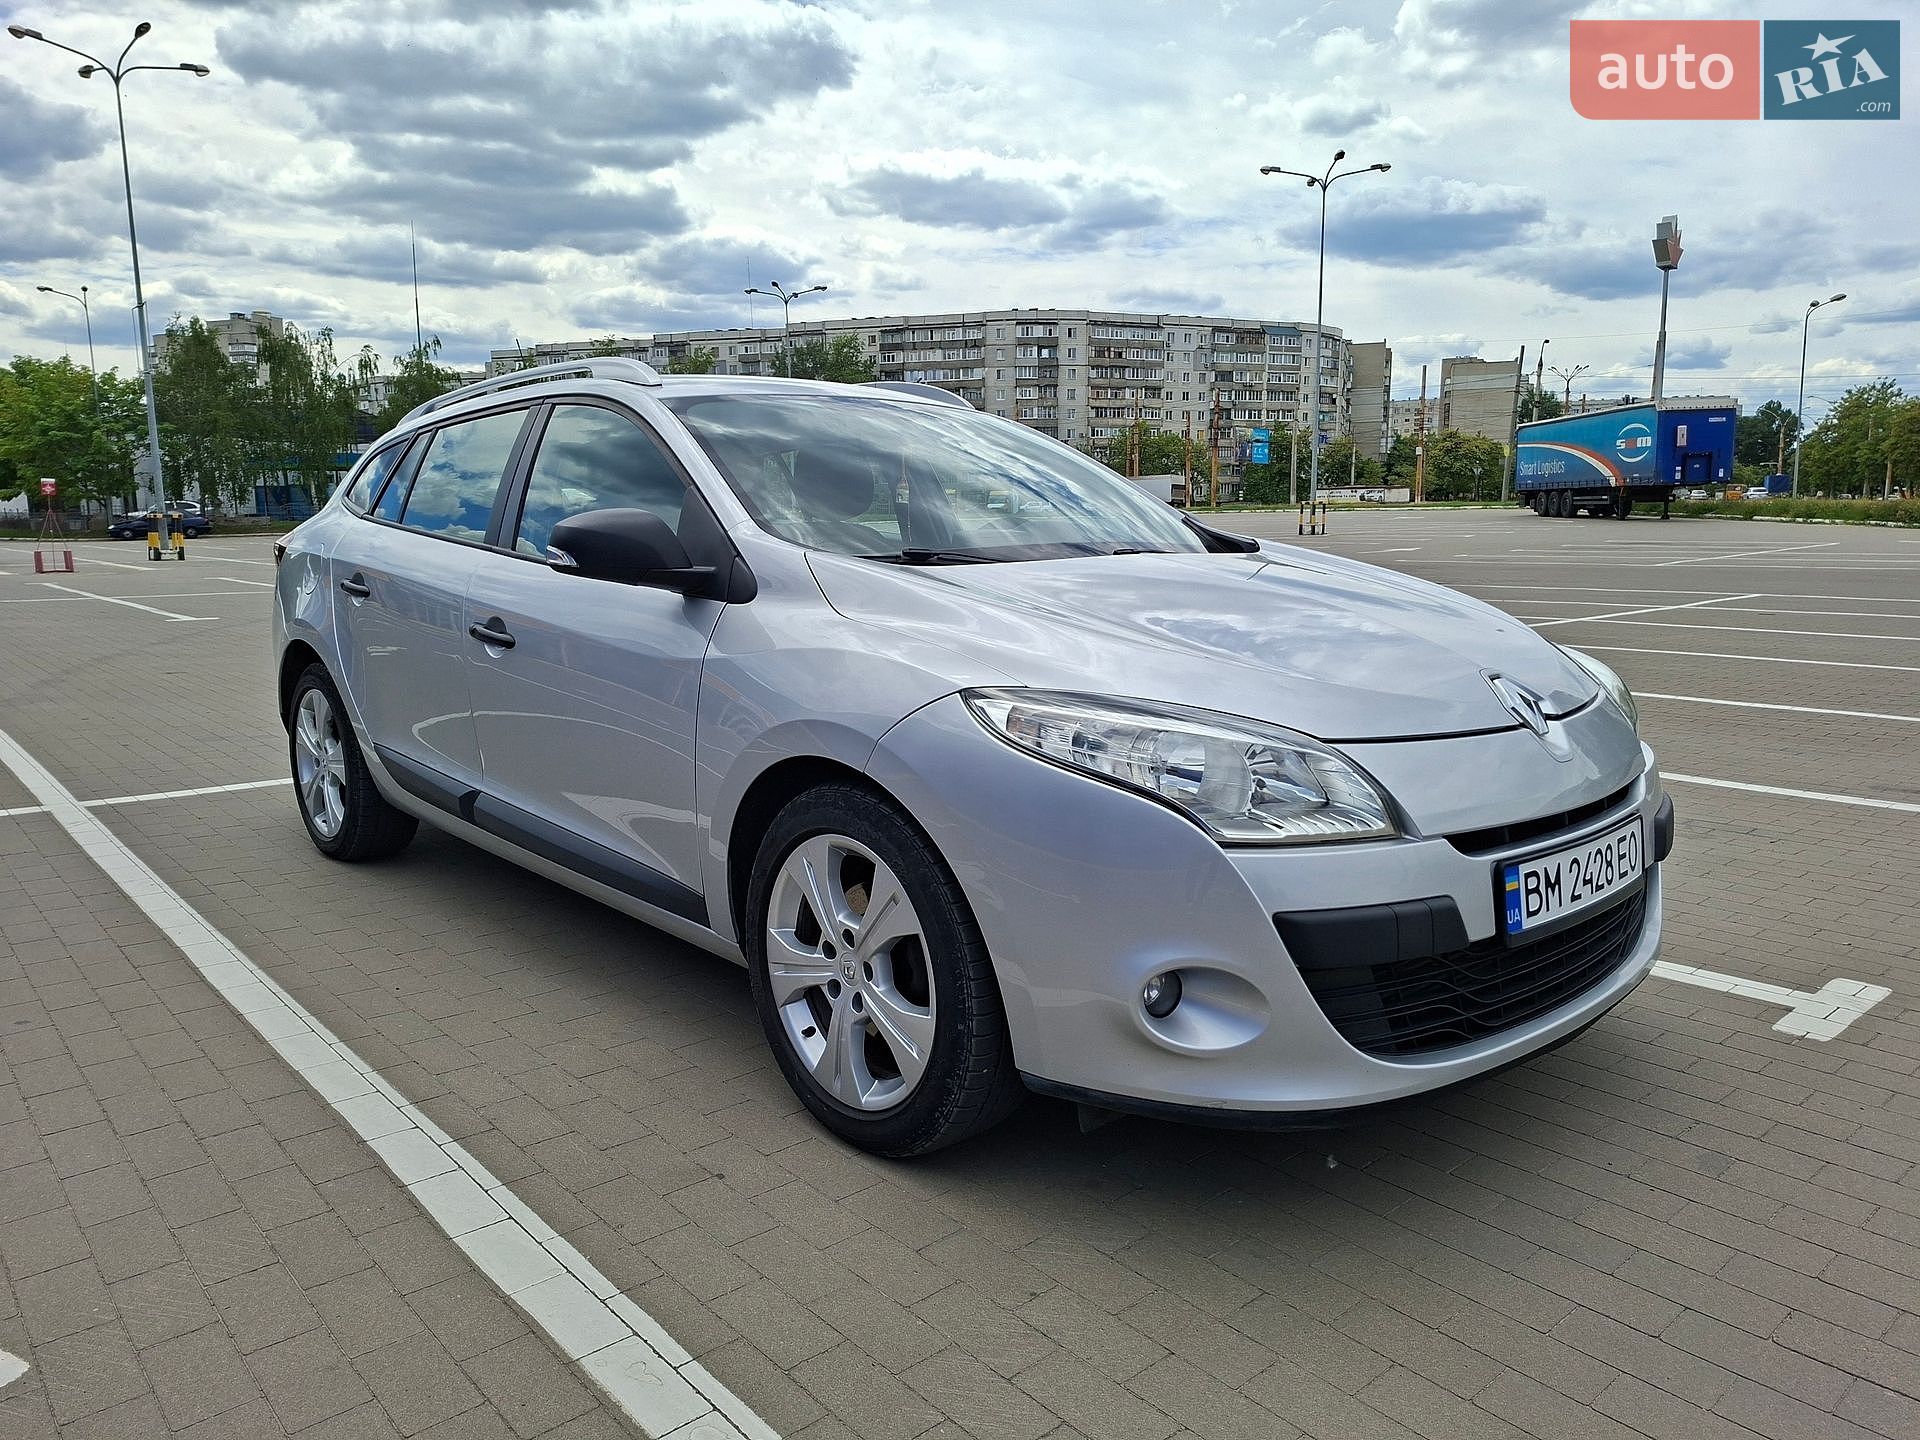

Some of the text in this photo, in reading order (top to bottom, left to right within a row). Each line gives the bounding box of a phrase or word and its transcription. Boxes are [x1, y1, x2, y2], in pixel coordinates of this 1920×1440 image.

[1520, 459, 1565, 478] Smart Logistics
[1523, 830, 1638, 919] BM 2428 EO
[1506, 909, 1521, 925] UA
